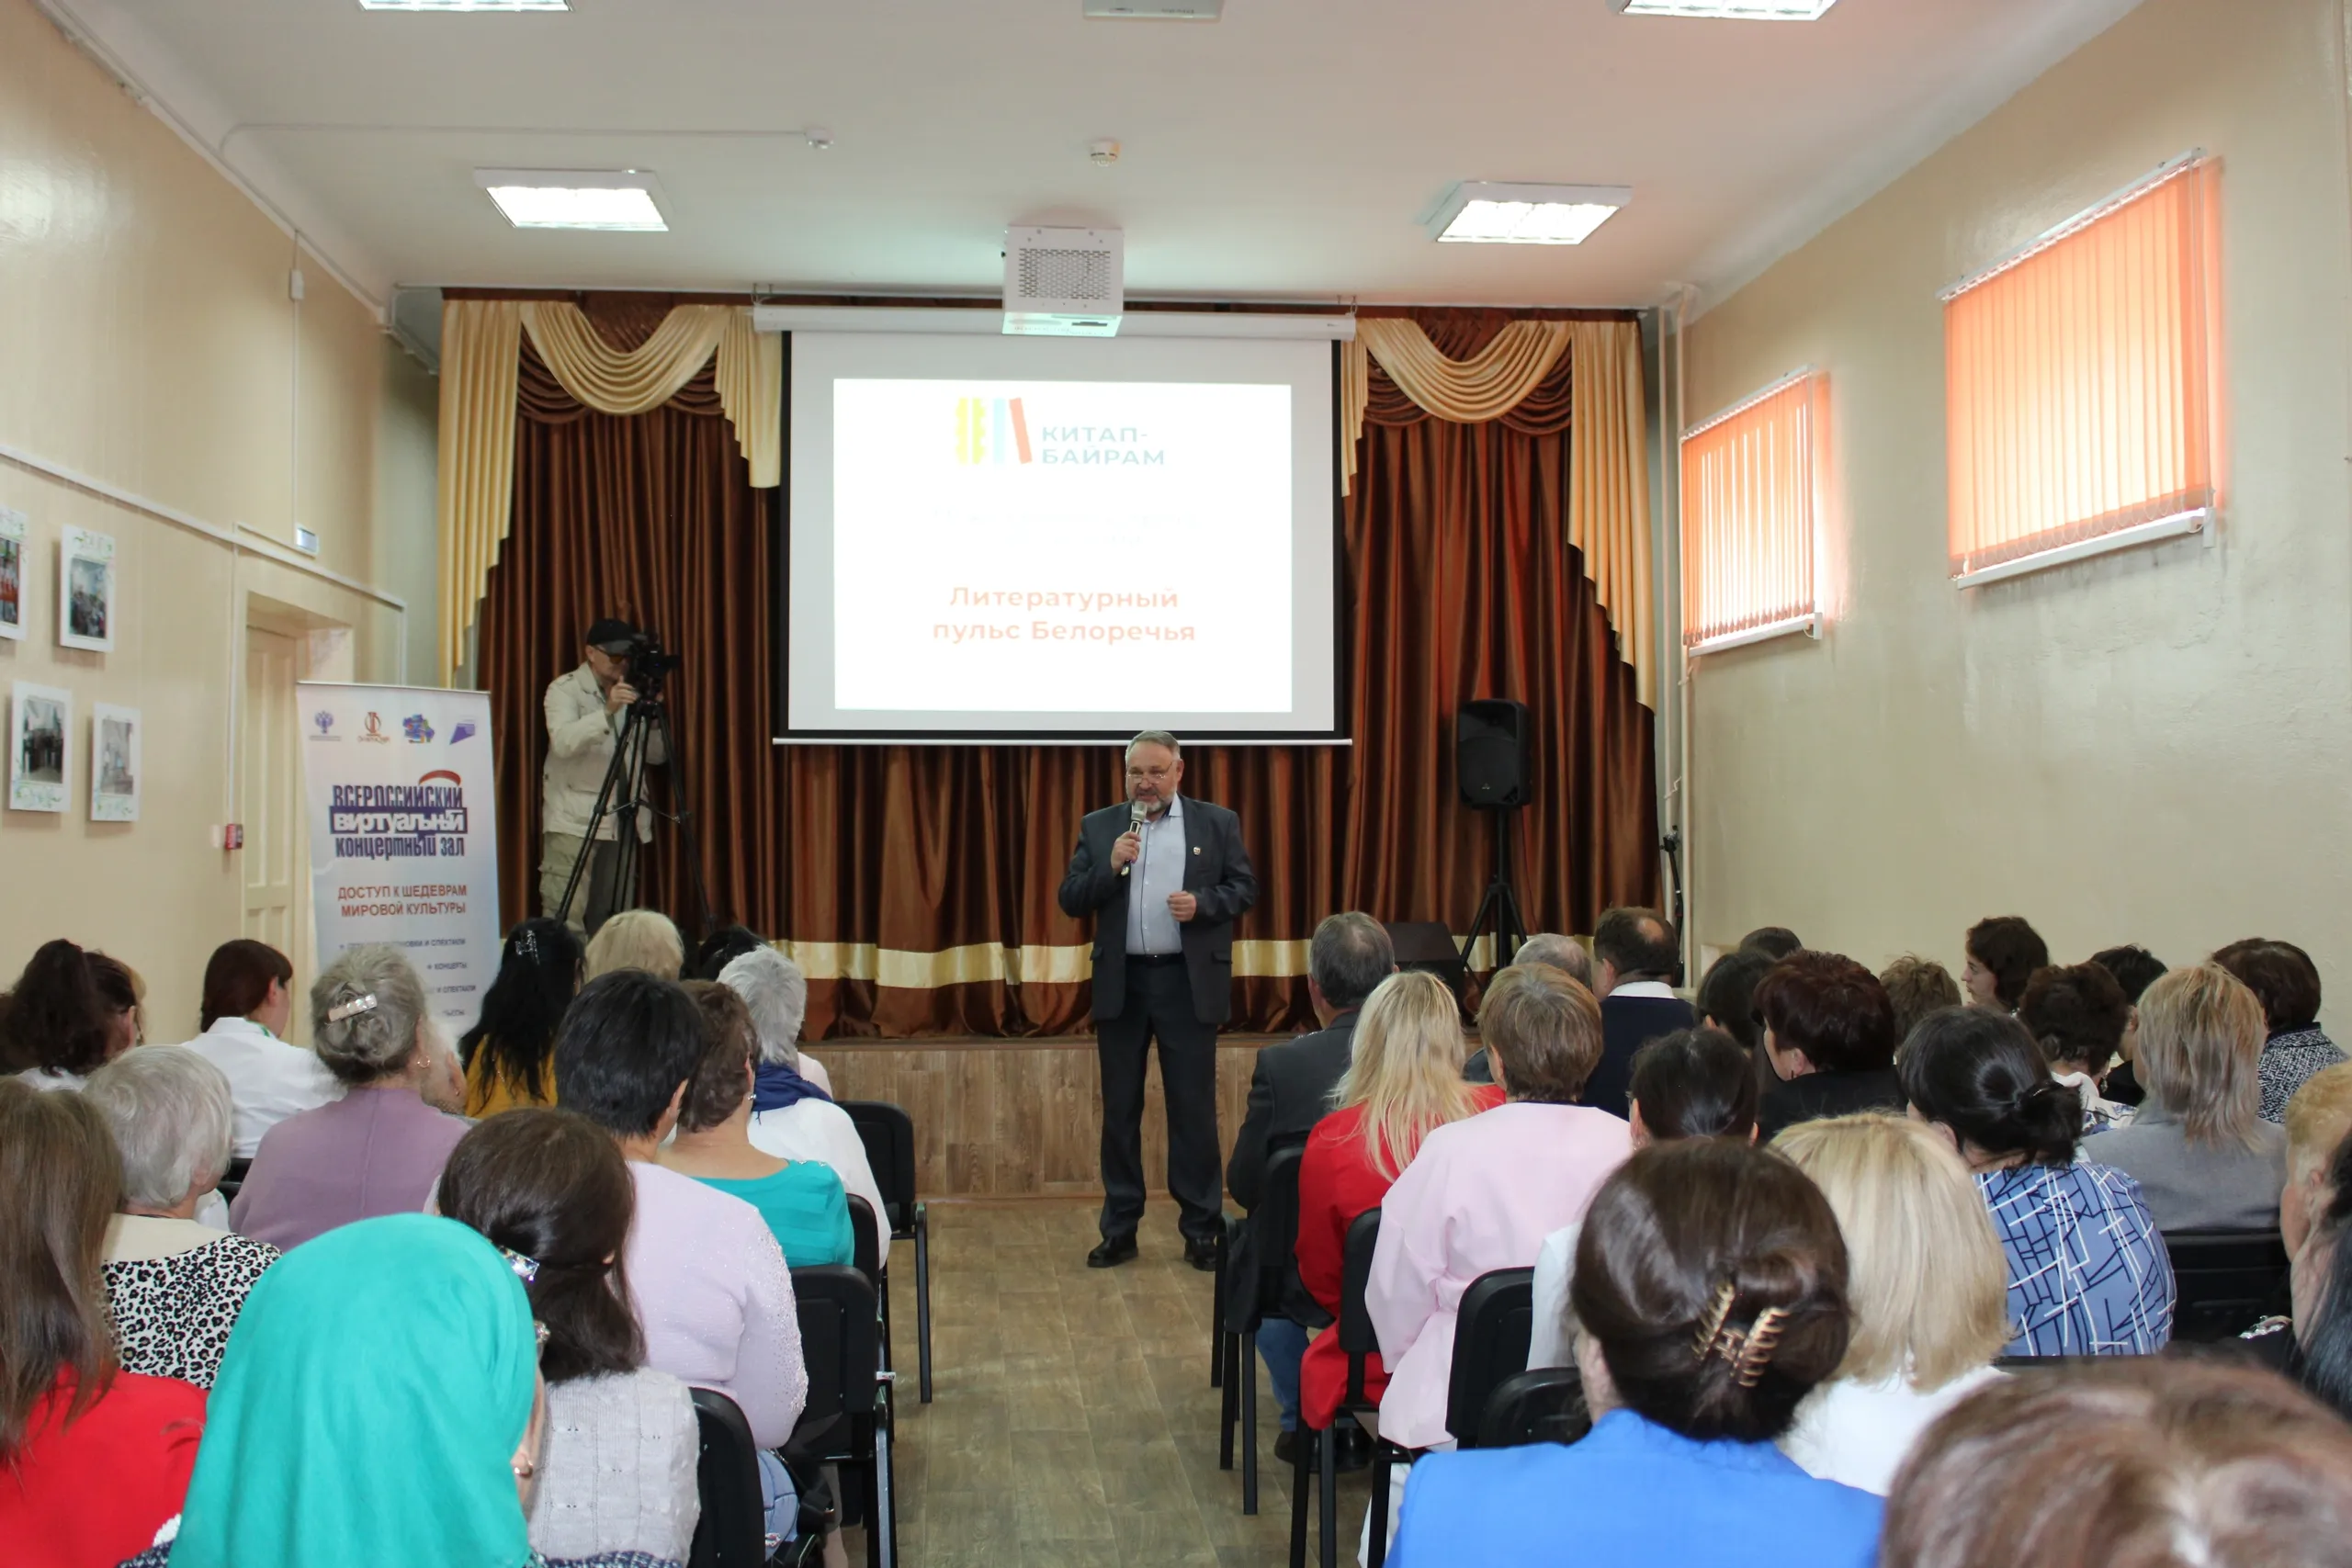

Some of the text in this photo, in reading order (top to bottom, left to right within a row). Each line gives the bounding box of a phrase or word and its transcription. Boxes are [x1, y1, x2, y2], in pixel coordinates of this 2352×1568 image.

[1042, 426, 1148, 443] КИТАП-
[1042, 445, 1165, 466] БАЙРАМ
[949, 585, 1179, 613] Литературный
[933, 621, 1196, 646] пульс Белоречья
[338, 884, 468, 901] ДОСТУП К ШЕДЕВРАМ
[341, 901, 467, 917] МИРОВОЙ КУЛЬТУРЫ
